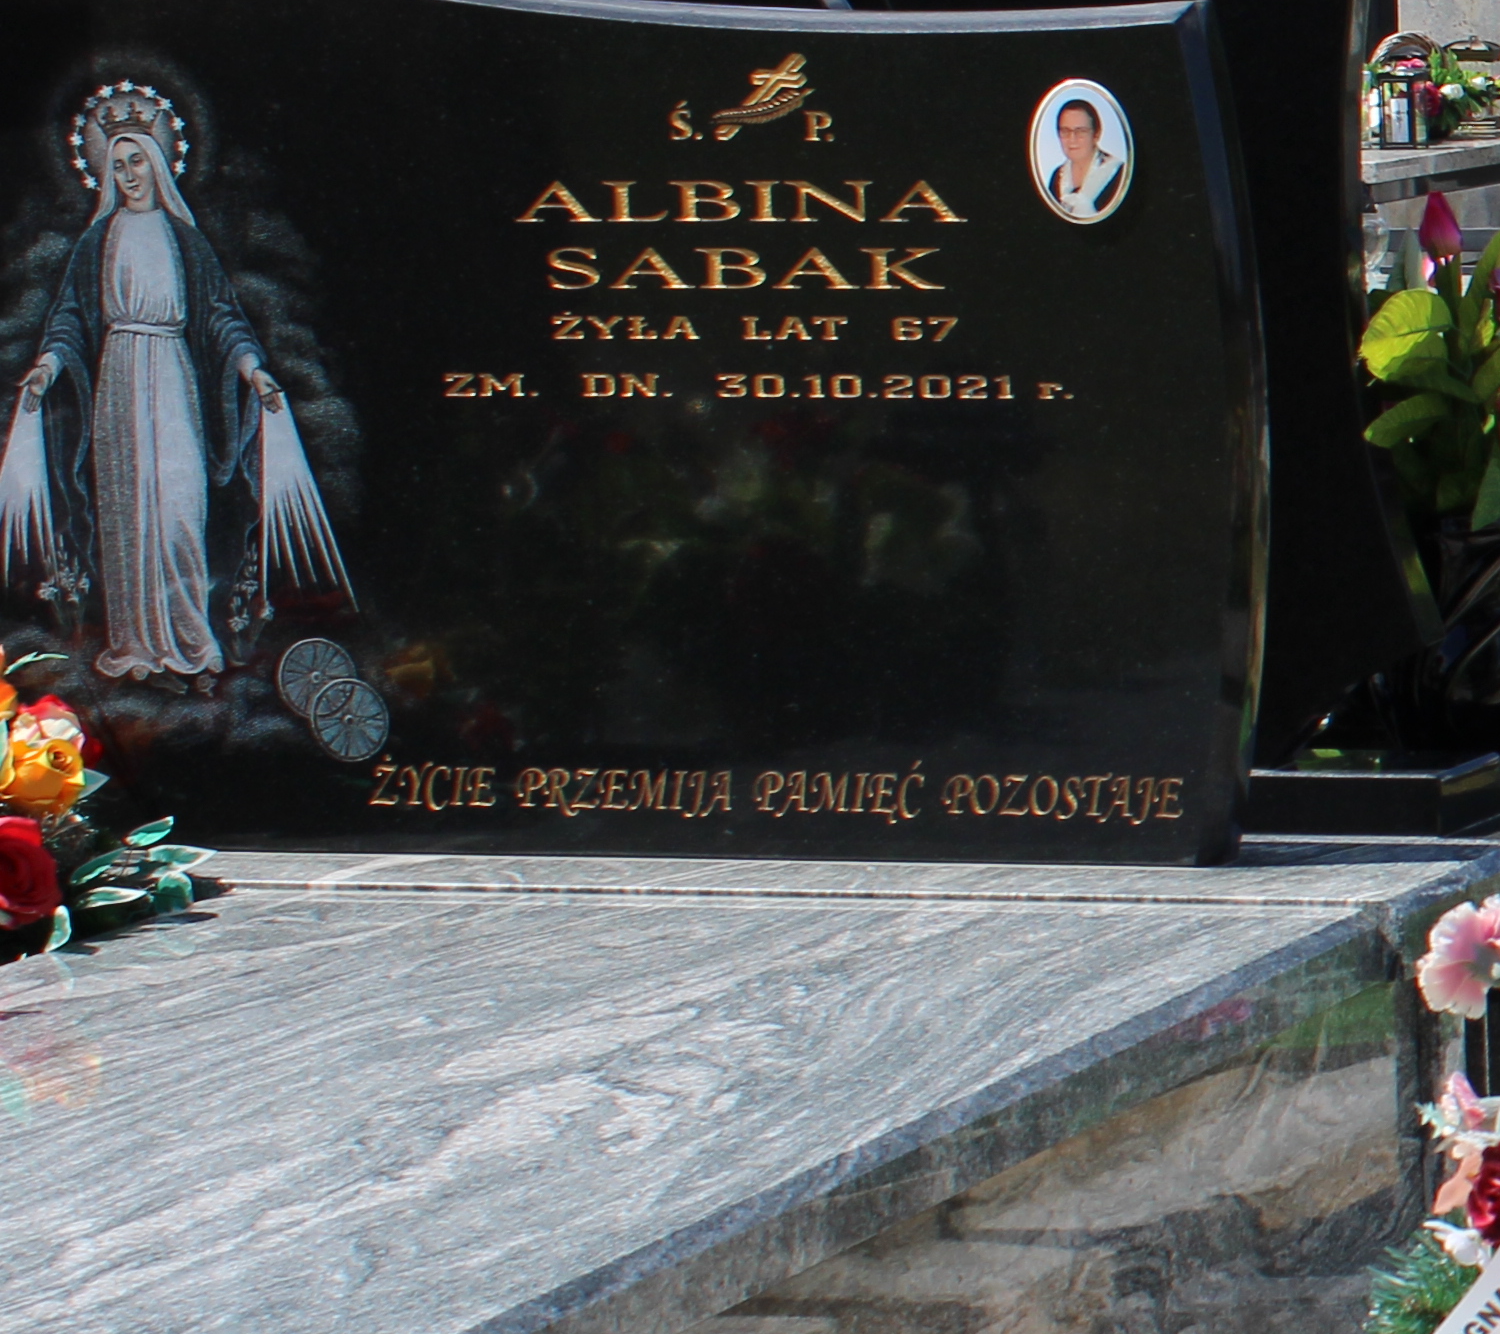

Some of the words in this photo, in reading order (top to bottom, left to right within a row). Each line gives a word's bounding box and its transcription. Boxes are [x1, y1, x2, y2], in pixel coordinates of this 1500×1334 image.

[669, 100, 704, 142] Ś.
[803, 111, 835, 142] P.
[514, 179, 969, 223] ALBINA
[546, 247, 947, 290] SABAK
[551, 311, 701, 341] ŻYŁA
[742, 316, 849, 341] LAT
[891, 316, 960, 341] 67
[443, 373, 539, 398] ZM.
[580, 373, 673, 398] DN.
[715, 373, 1015, 400] 30.10.2021
[1037, 380, 1075, 400] r.
[368, 755, 497, 811] ŻYCIE
[515, 767, 734, 818] PRZEMIJA
[753, 761, 927, 826] PAMIĘĆ
[941, 772, 1185, 826] POZOSTAJE
